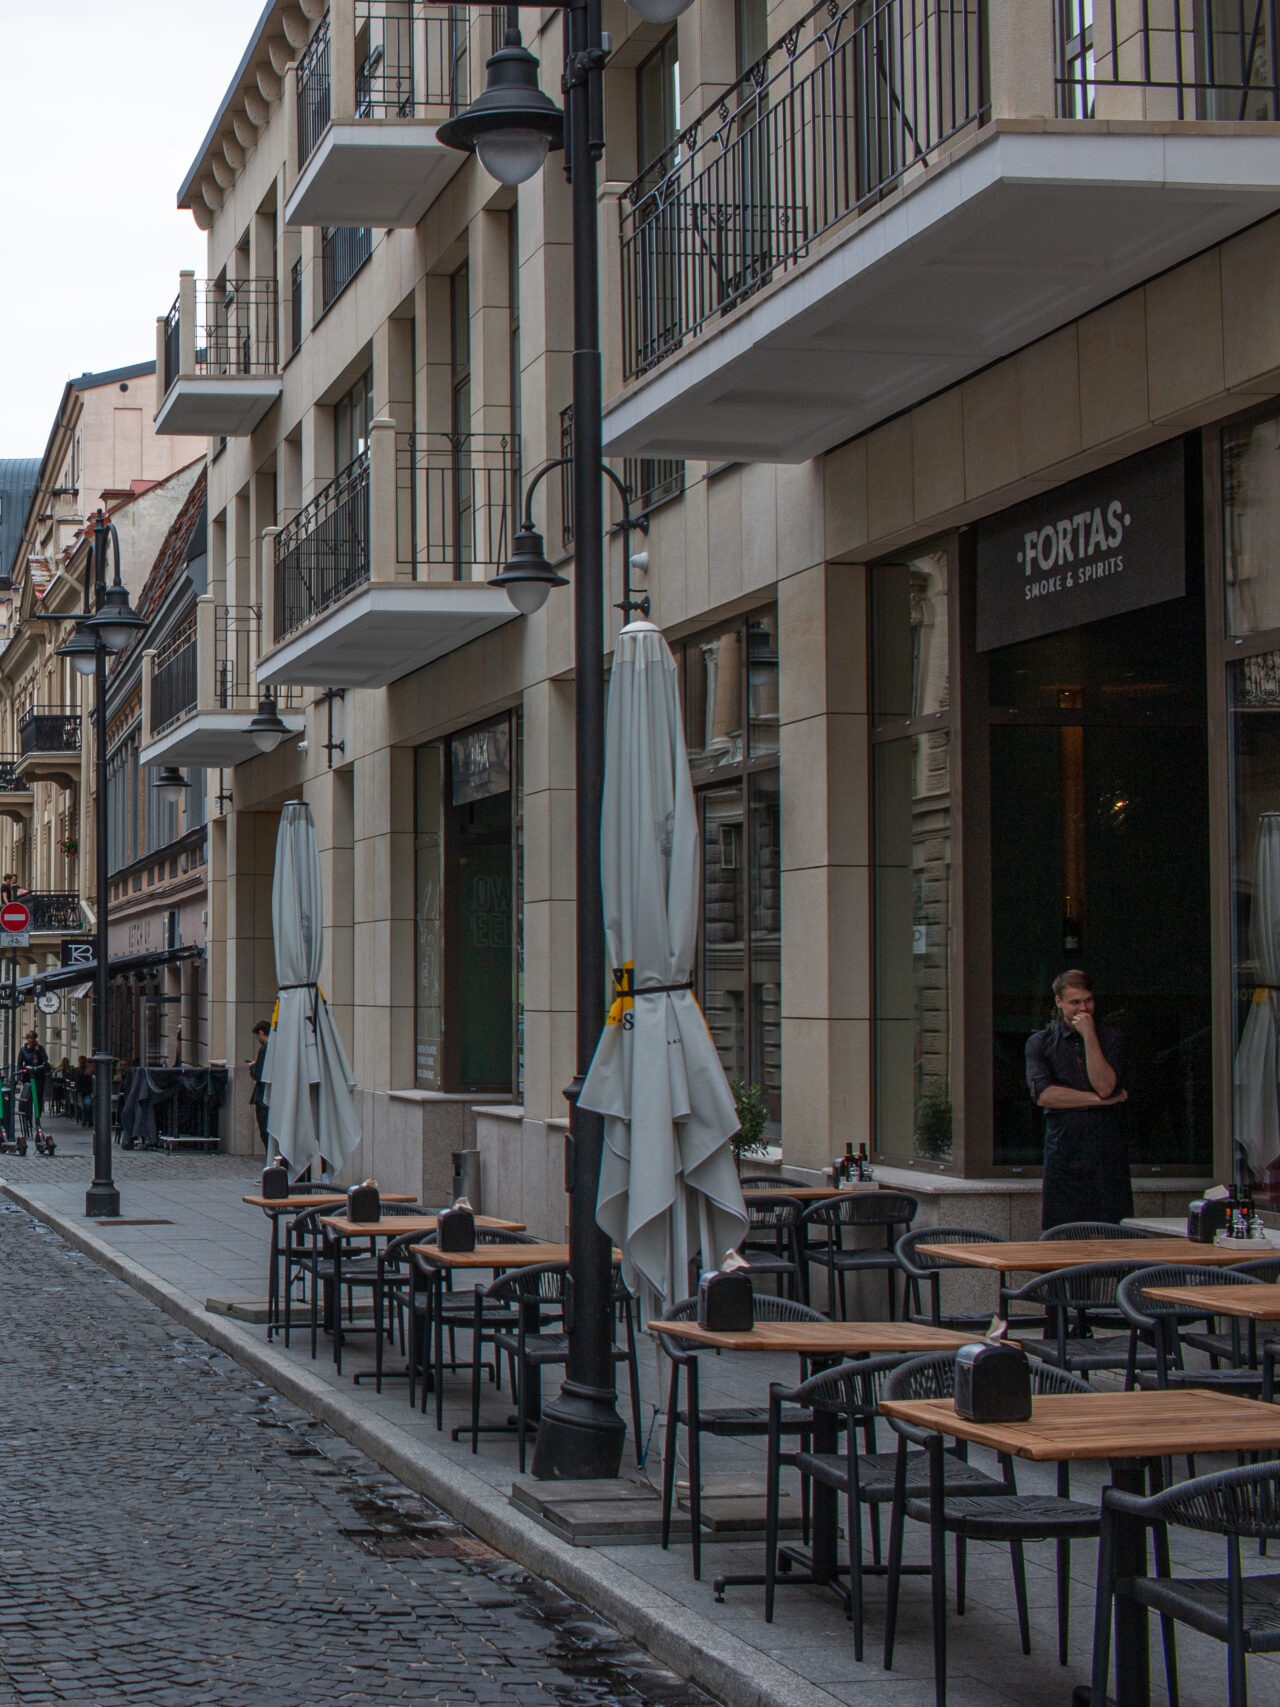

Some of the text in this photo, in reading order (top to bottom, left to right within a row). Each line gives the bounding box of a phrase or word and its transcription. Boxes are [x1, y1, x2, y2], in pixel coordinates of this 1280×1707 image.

[1023, 500, 1124, 577] FORTAS
[1024, 555, 1124, 600] SMOKE & SPIRITS
